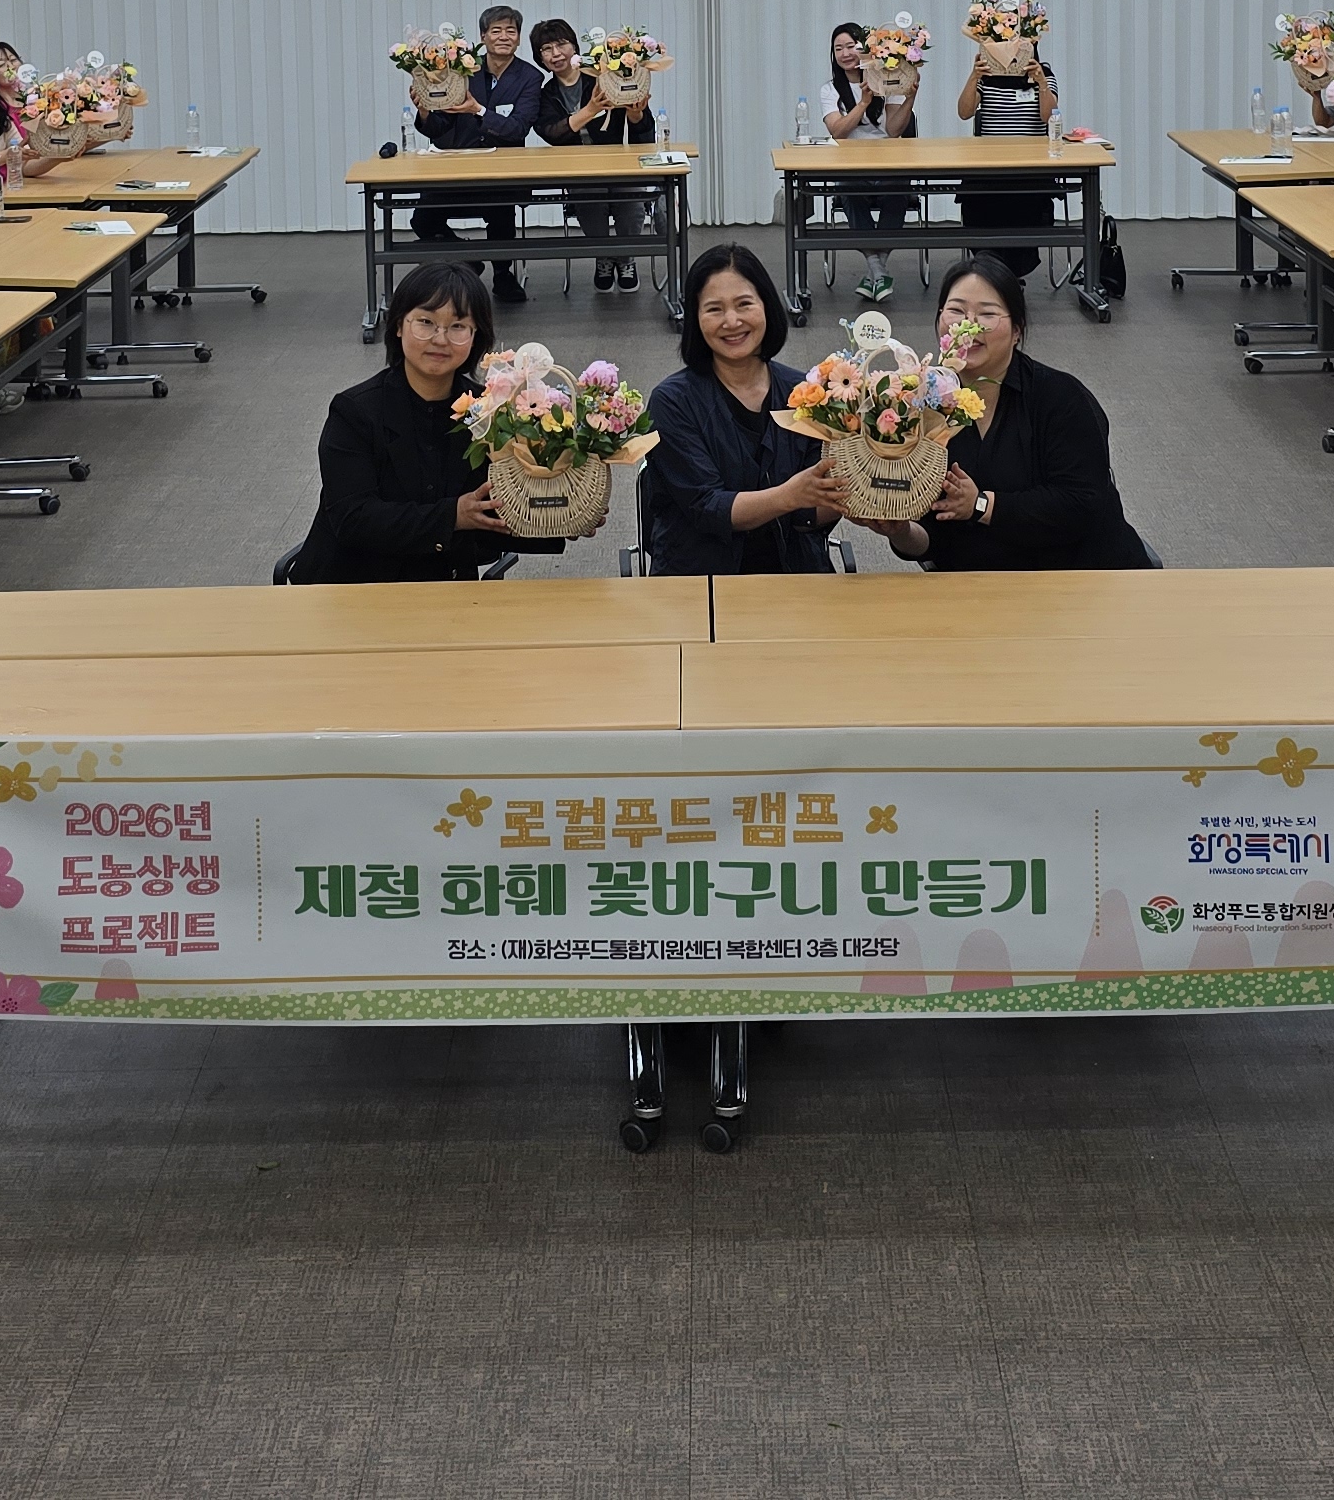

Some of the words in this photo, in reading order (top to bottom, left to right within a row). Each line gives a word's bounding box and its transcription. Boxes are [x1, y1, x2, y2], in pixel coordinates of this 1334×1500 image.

[65, 801, 211, 841] 2026년
[500, 796, 716, 850] 로컬푸드
[733, 791, 844, 847] 캠프
[1200, 816, 1231, 828] 특별한
[1234, 816, 1259, 828] 시민,
[1262, 816, 1293, 827] 빛나는
[1296, 816, 1317, 827] 도시
[1188, 833, 1330, 864] 화성특례시
[58, 855, 220, 897] 도농상생
[1209, 867, 1254, 875] HWASEONG
[1256, 867, 1288, 875] SPECIAL
[1290, 867, 1308, 875] CITY
[295, 864, 420, 919] 제철
[441, 864, 566, 917] 화훼
[587, 861, 837, 918] 꽃바구니
[861, 859, 1047, 917] 만들기
[61, 912, 219, 956] 프로젝트
[1192, 924, 1232, 933] Hwaseong
[1234, 924, 1254, 932] Food
[1257, 923, 1299, 933] Integration
[1302, 922, 1332, 931] Support
[447, 939, 486, 960] 장소
[501, 939, 722, 960] (재)화성푸드통합지원센터
[726, 938, 802, 959] 복합센터
[807, 938, 838, 958] 3층
[842, 937, 900, 957] 대강당
